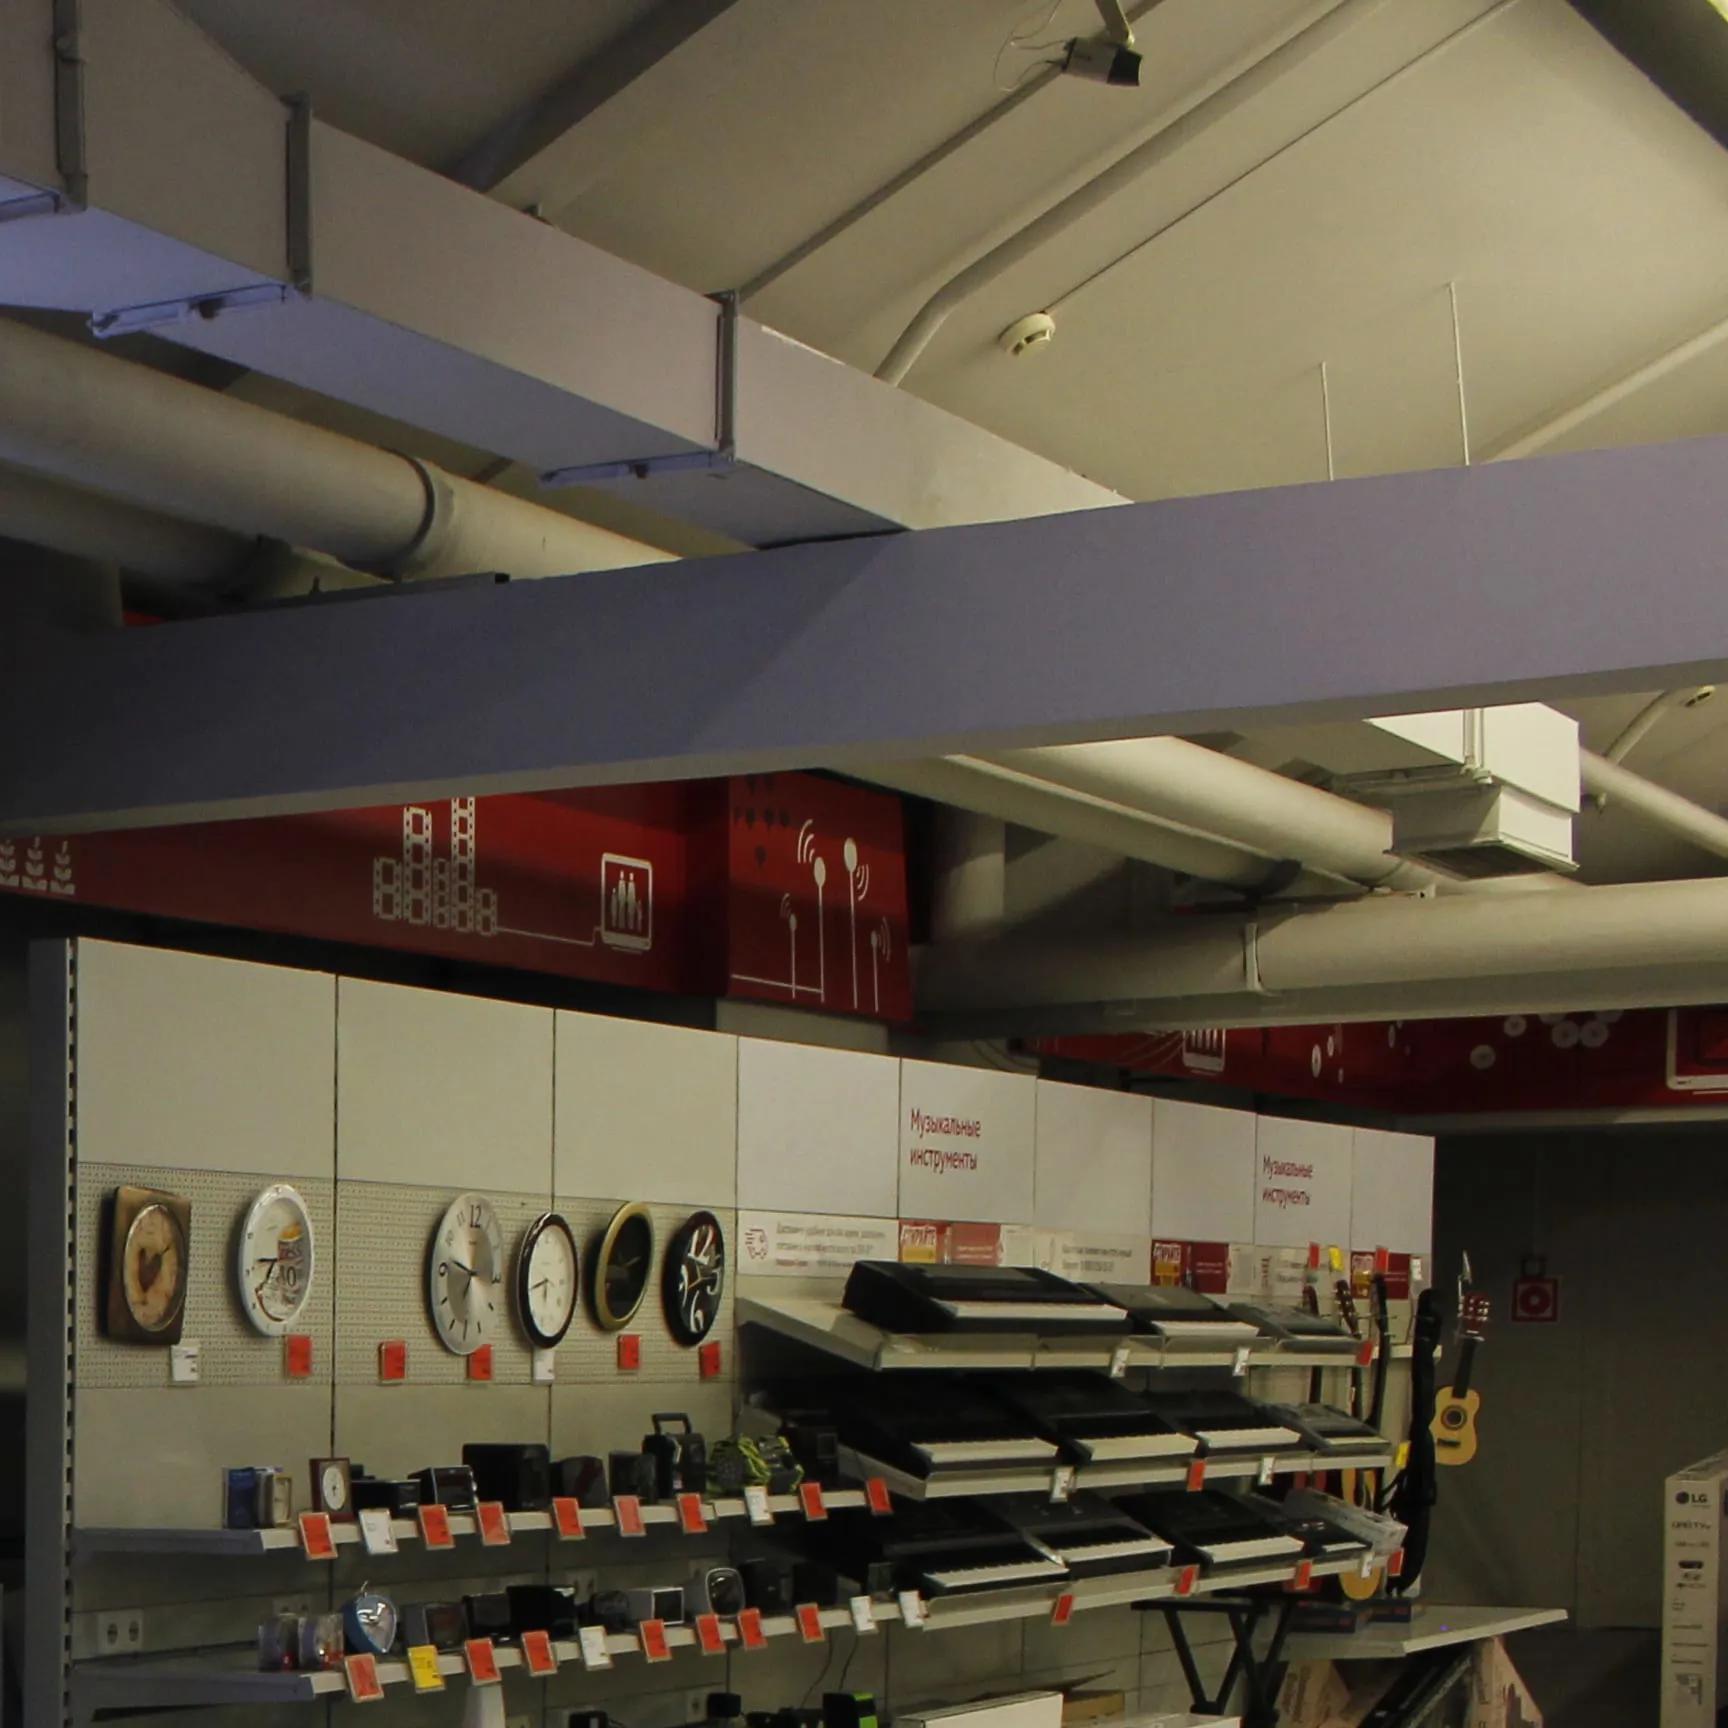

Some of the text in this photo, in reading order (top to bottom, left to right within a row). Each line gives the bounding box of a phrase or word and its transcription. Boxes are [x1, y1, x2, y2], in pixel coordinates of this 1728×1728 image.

[910, 1108, 981, 1139] Музыкальные
[910, 1148, 977, 1174] инструменты
[1691, 1493, 1708, 1504] LG
